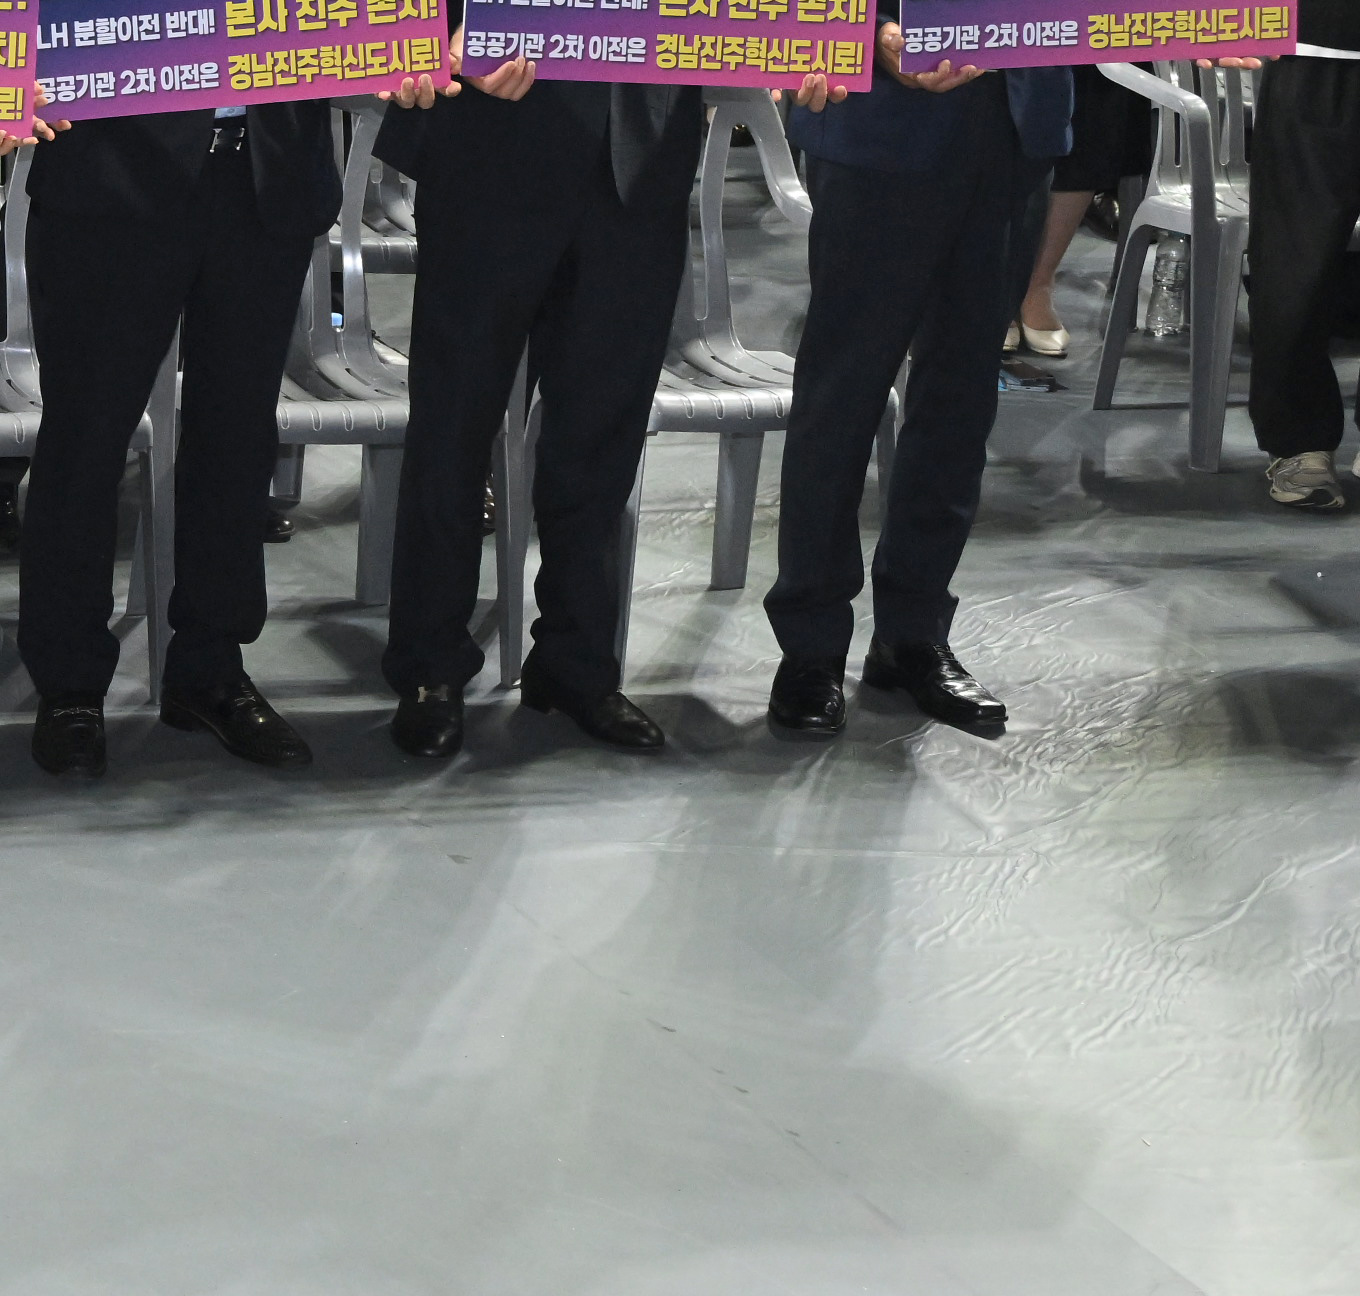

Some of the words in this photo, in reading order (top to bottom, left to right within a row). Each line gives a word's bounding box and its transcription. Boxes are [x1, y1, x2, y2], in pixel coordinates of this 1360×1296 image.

[37, 22, 68, 49] LH
[74, 15, 161, 47] 분할이전
[166, 8, 215, 38] 반대!
[905, 26, 980, 53] 공공기관
[985, 24, 1019, 48] 2차
[1023, 20, 1078, 47] 이전은
[1087, 6, 1288, 49] 경남진주혁신도시로!
[37, 71, 115, 104] 공공기관
[120, 69, 156, 95] 2차
[163, 62, 219, 91] 이전은
[228, 37, 440, 90] 경남진주혁신도시로!
[467, 31, 545, 59] 공공기관
[548, 34, 584, 60] 2차
[588, 36, 646, 63] 이전은
[655, 33, 863, 74] 경남진주혁신도시로!
